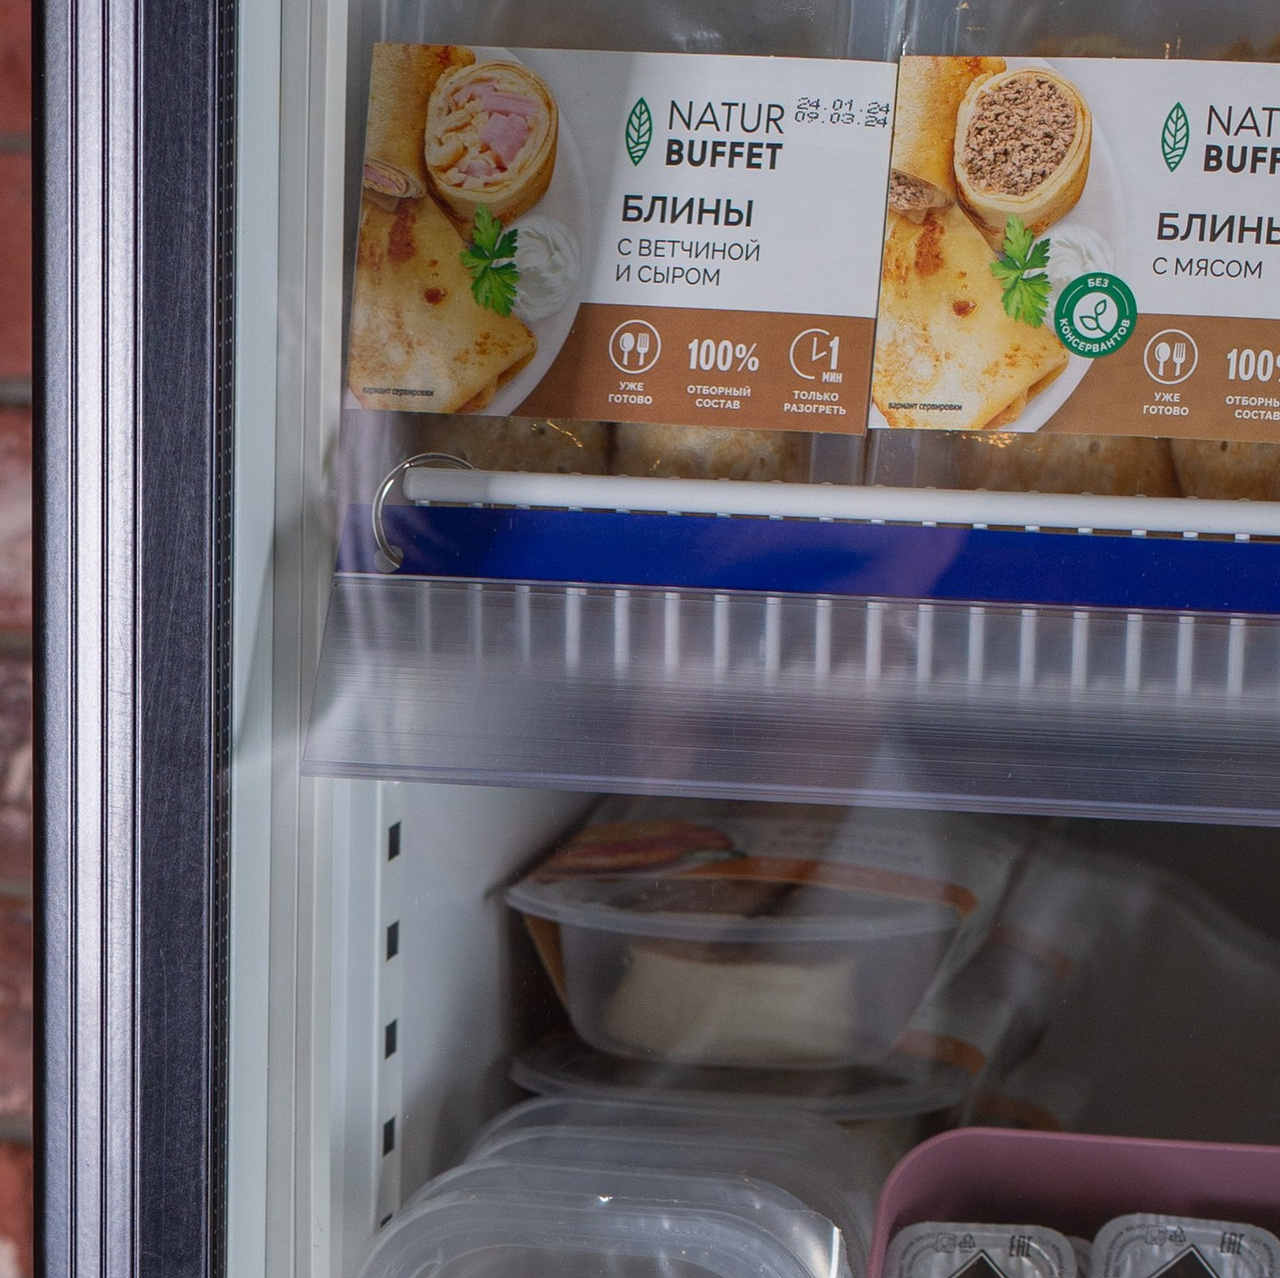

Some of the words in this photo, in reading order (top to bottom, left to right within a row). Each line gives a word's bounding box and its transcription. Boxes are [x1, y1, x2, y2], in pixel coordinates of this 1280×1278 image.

[796, 97, 891, 115] 24.01.24
[668, 100, 785, 134] NATUR
[794, 111, 889, 128] 09.03.24
[665, 138, 783, 170] BUFFET
[621, 194, 754, 228] БЛИНЫ
[617, 238, 633, 256] С
[638, 238, 761, 262] ВЕТЧИНОЙ
[615, 264, 631, 282] И
[637, 265, 720, 286] СЫРОМ
[1152, 257, 1168, 275] С
[1174, 257, 1263, 279] МЯСОМ
[1087, 278, 1109, 288] БЕЗ
[1059, 318, 1131, 353] КОНСЕРВАНТОВ
[688, 338, 760, 372] 100%
[1227, 349, 1280, 382] 100
[822, 371, 843, 384] МИН
[619, 380, 644, 392] УЖЕ
[687, 384, 751, 397] ОТБОРНЫЙ
[608, 393, 653, 405] ГОТОВО
[793, 390, 840, 402] ТОЛЬКО
[1154, 392, 1181, 403] УЖЕ
[695, 398, 741, 410] СОСТАВ
[783, 402, 847, 415] РАЗОГРЕТЬ
[1143, 404, 1189, 416] ГОТОВО
[1235, 409, 1280, 421] СОСТАВ
